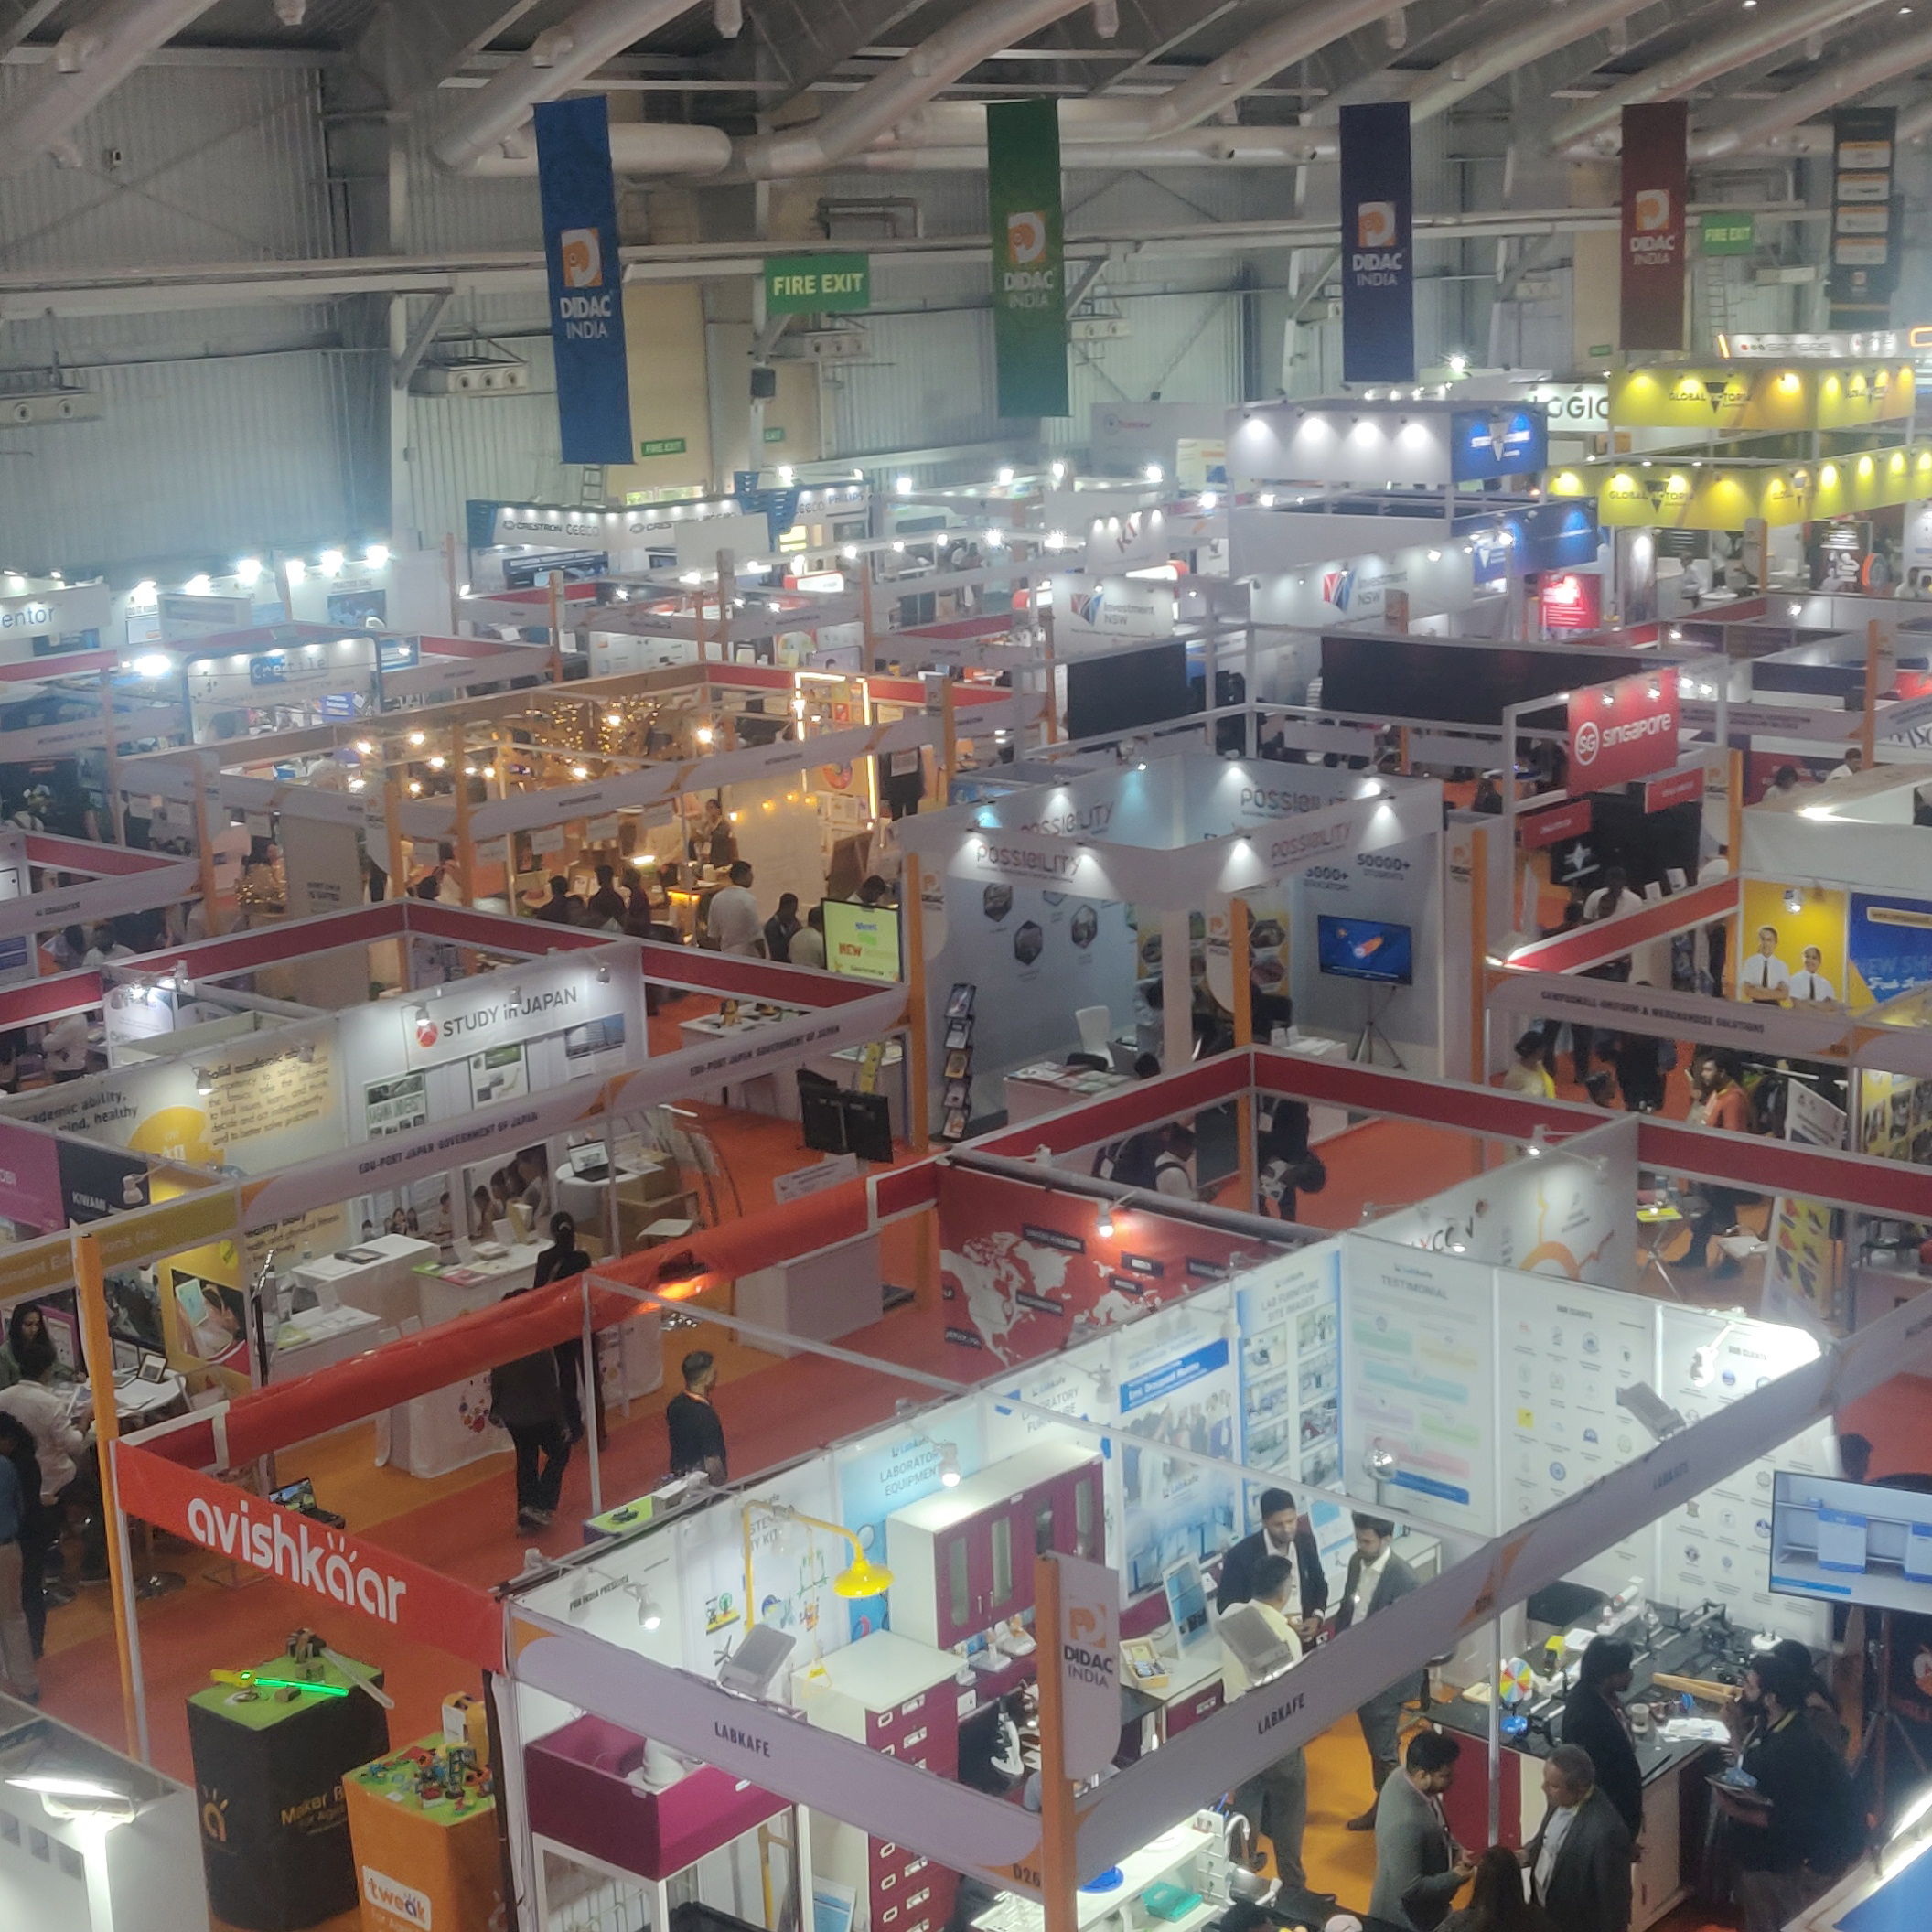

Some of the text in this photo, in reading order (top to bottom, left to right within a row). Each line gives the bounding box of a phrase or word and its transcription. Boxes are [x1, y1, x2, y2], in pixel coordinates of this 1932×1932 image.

[1630, 235, 1675, 252] DIDAC
[1705, 226, 1751, 242] FIRE EXIT
[1353, 252, 1403, 271] DIDAC
[1634, 252, 1671, 265] INDIA
[773, 273, 864, 295] FIRE EXIT
[1004, 270, 1054, 290] DIDAC
[1357, 273, 1398, 286] INDIA
[560, 295, 612, 318] DIDAC
[1009, 293, 1049, 308] INDIA
[566, 321, 609, 339] INDIA
[1578, 734, 1596, 755] SG
[1602, 713, 1671, 748] singapore
[1021, 801, 1114, 836] OSSIBILITY
[1272, 822, 1351, 859] POSSIBILITY
[976, 844, 1082, 875] POSSIBILITY
[443, 986, 577, 1037] STUDY in JAPAN
[26, 1102, 78, 1124] ademic
[94, 1104, 139, 1124] healthy
[359, 1152, 402, 1175] EDU-PORT
[438, 1124, 496, 1150] GOVERNMENT
[879, 1445, 941, 1483] LABORATOR
[885, 1465, 938, 1497] EQUIPMEN
[187, 1498, 407, 1625] avishkaar
[1064, 1644, 1113, 1675] DIDAC
[1068, 1664, 1110, 1689] INDIA
[1258, 1692, 1304, 1735] LABKAFE
[714, 1721, 770, 1758] LABKAFE
[368, 1878, 426, 1925] tweak
